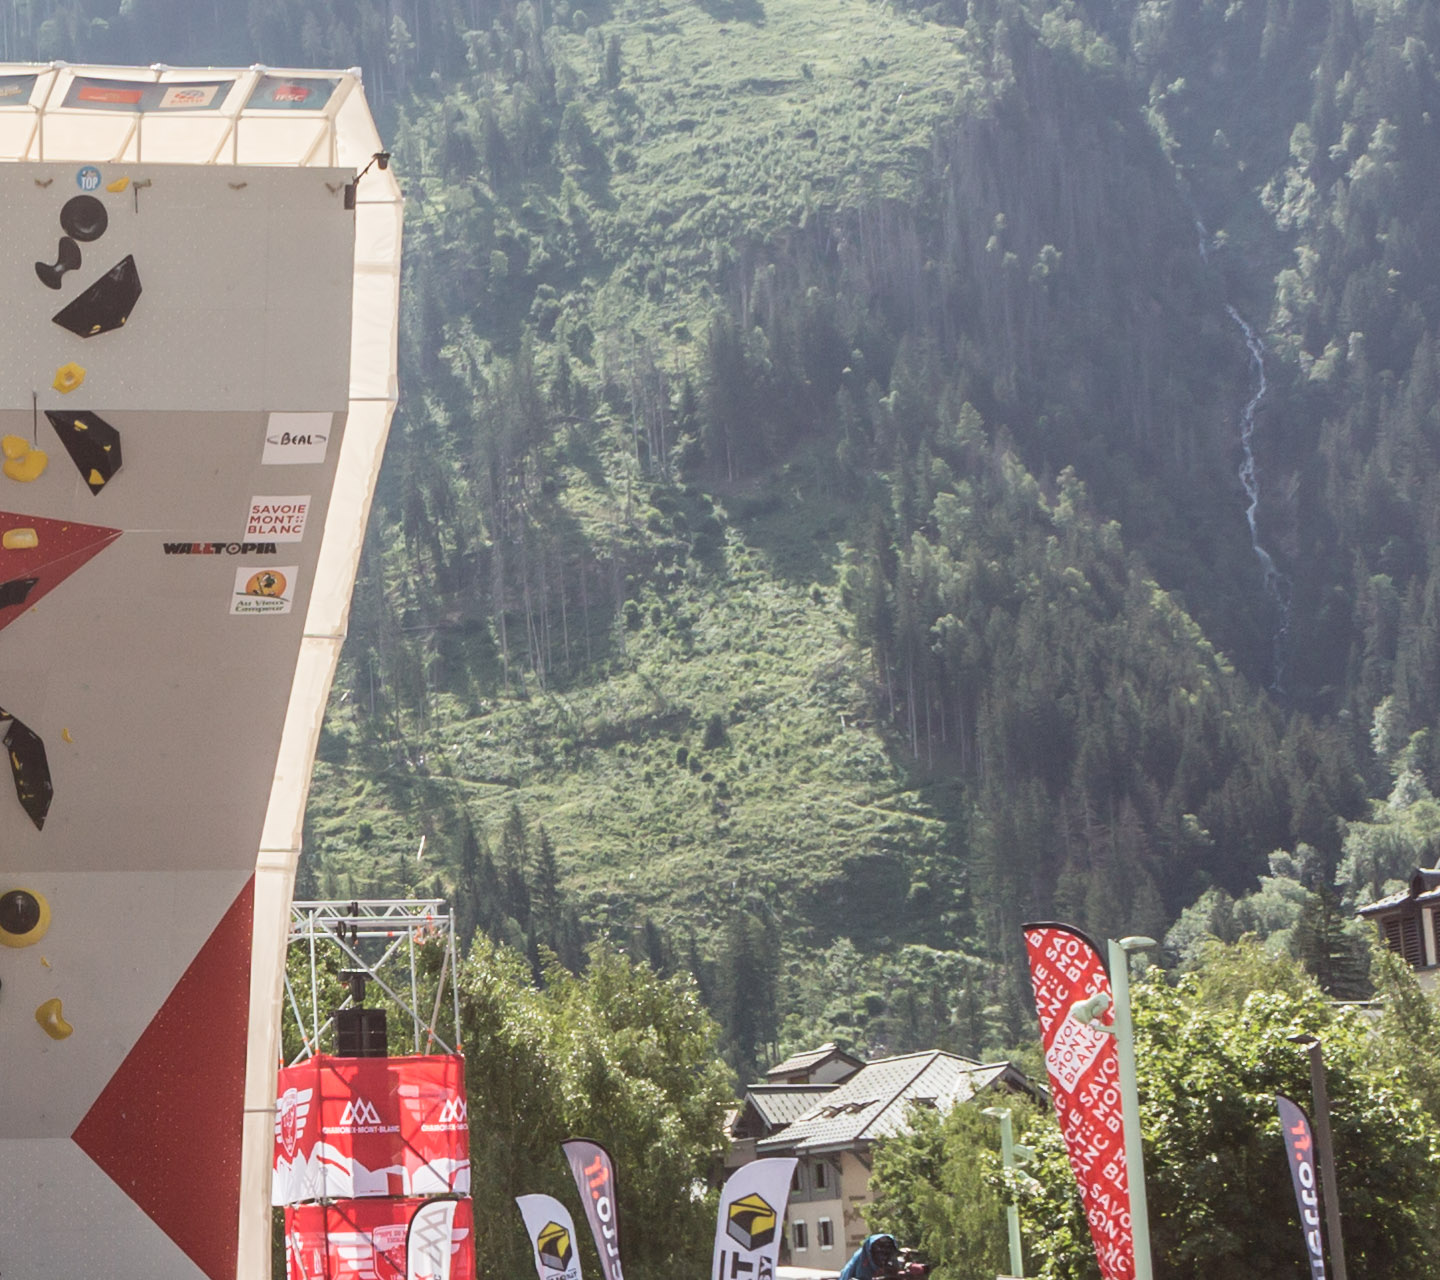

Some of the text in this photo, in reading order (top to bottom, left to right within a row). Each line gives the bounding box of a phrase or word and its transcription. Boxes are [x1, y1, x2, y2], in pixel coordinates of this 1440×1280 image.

[81, 177, 99, 190] TOP
[280, 432, 313, 446] BEAL
[252, 504, 307, 514] SAVOIE
[249, 516, 293, 524] MONT
[247, 525, 303, 535] BLANC
[163, 542, 277, 556] WALLTOPIA
